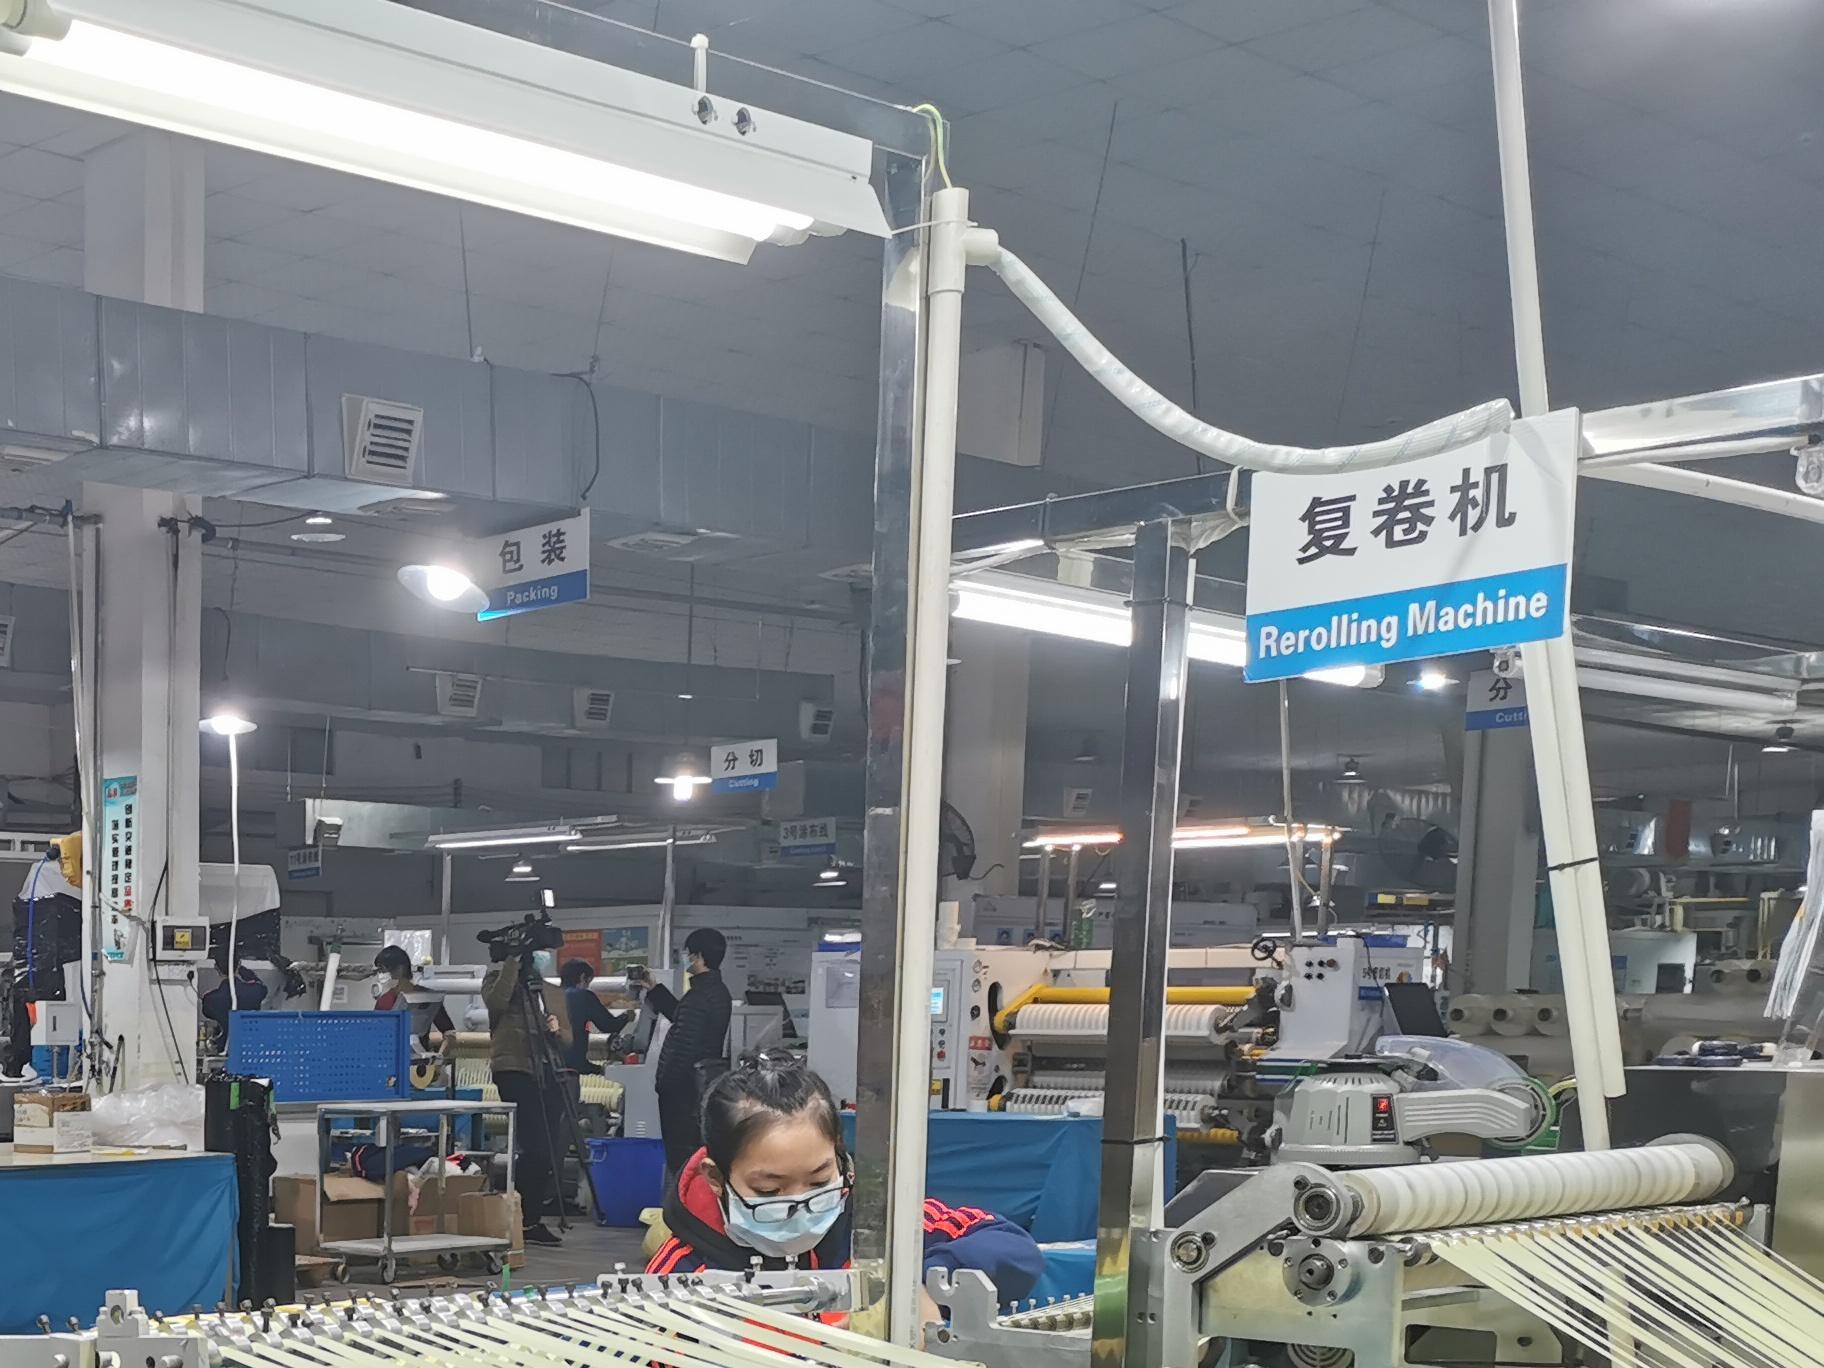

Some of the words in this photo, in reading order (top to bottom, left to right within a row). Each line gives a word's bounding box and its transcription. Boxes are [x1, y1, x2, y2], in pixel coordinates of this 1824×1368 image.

[1296, 463, 1517, 565] 复卷机
[498, 527, 567, 574] 包装
[506, 585, 558, 606] Packing
[1258, 611, 1399, 659] Rerolling
[1406, 588, 1549, 638] Machine
[1488, 677, 1513, 702] 分
[1495, 711, 1528, 723] Cutti
[723, 749, 764, 771] 分切
[728, 777, 760, 788] Cutting
